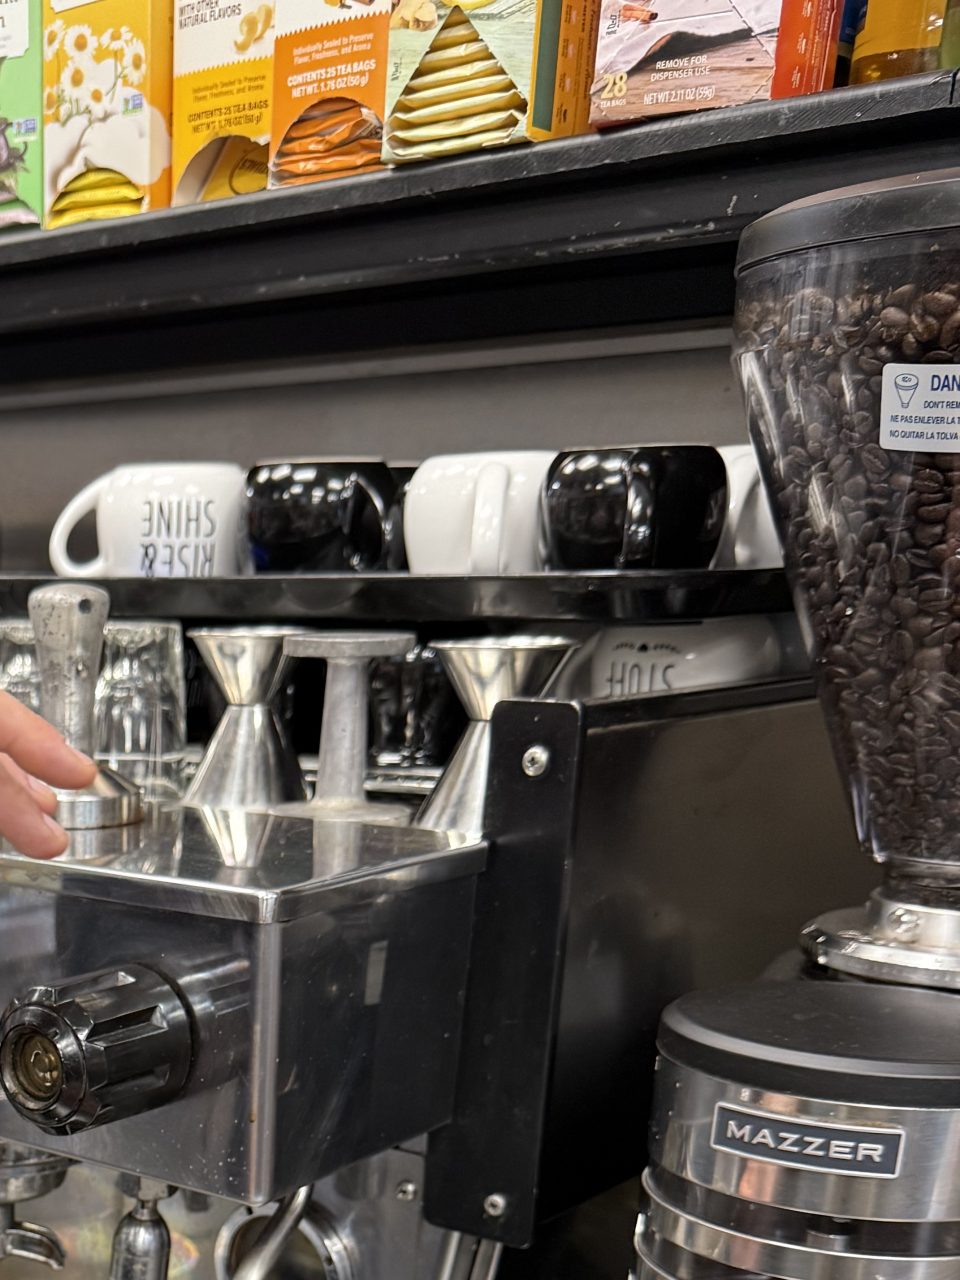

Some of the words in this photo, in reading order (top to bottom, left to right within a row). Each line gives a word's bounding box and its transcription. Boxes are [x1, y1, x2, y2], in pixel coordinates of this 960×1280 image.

[209, 3, 242, 21] FLAVORS
[655, 58, 690, 70] REMOVE
[690, 55, 708, 66] FOR
[287, 68, 326, 87] CONTENTS
[336, 62, 352, 76] TEA
[352, 58, 376, 73] BAGS
[650, 69, 694, 82] DISPENSER
[695, 66, 711, 76] USE
[601, 71, 628, 99] 28
[643, 92, 657, 105] NET
[670, 89, 684, 102] 2.11
[685, 87, 696, 101] OZ
[923, 400, 946, 409] DON'T
[890, 414, 899, 423] NE
[900, 415, 913, 424] PAS
[913, 415, 946, 425] ENLEVER
[946, 416, 956, 425] LA
[889, 429, 899, 438] NO
[900, 430, 925, 439] QUITAR
[926, 431, 935, 440] LA
[935, 431, 959, 441] TOLVA
[141, 499, 217, 538] SHINE
[161, 543, 217, 578] RISE
[726, 1119, 885, 1164] MAZZER
